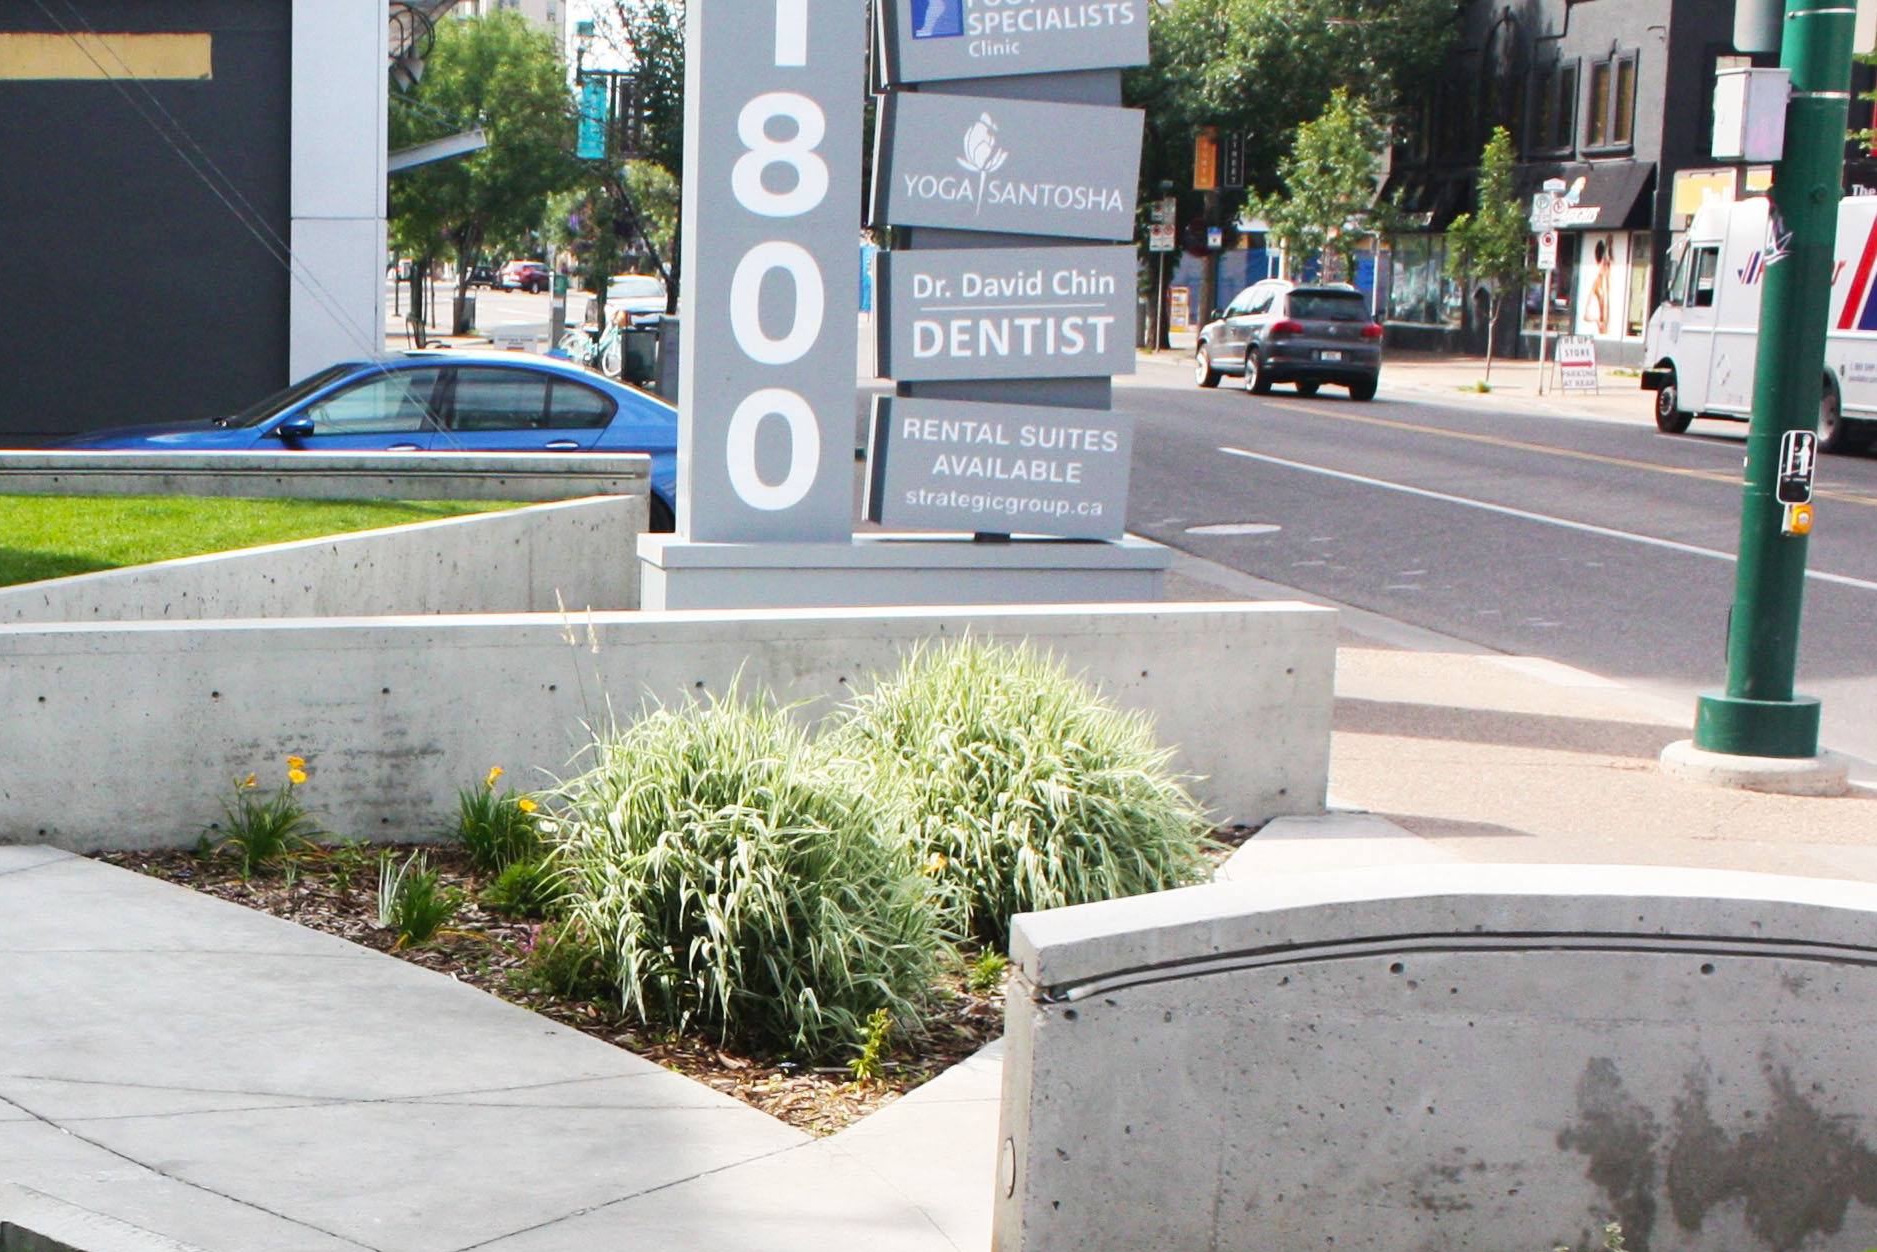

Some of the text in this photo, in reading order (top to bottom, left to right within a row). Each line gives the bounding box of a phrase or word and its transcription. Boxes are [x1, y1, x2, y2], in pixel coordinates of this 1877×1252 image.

[968, 2, 1135, 36] SPECIALISTS
[969, 39, 1020, 57] Clinic
[904, 174, 1124, 213] YOGA SANTOSHA
[913, 269, 1115, 298] Dr. David Chin
[913, 316, 1115, 358] DENTIST
[903, 418, 1119, 452] RENTAL SUITES
[932, 454, 1083, 484] AVAILABLE
[906, 489, 1103, 517] strategicgroup.ca
